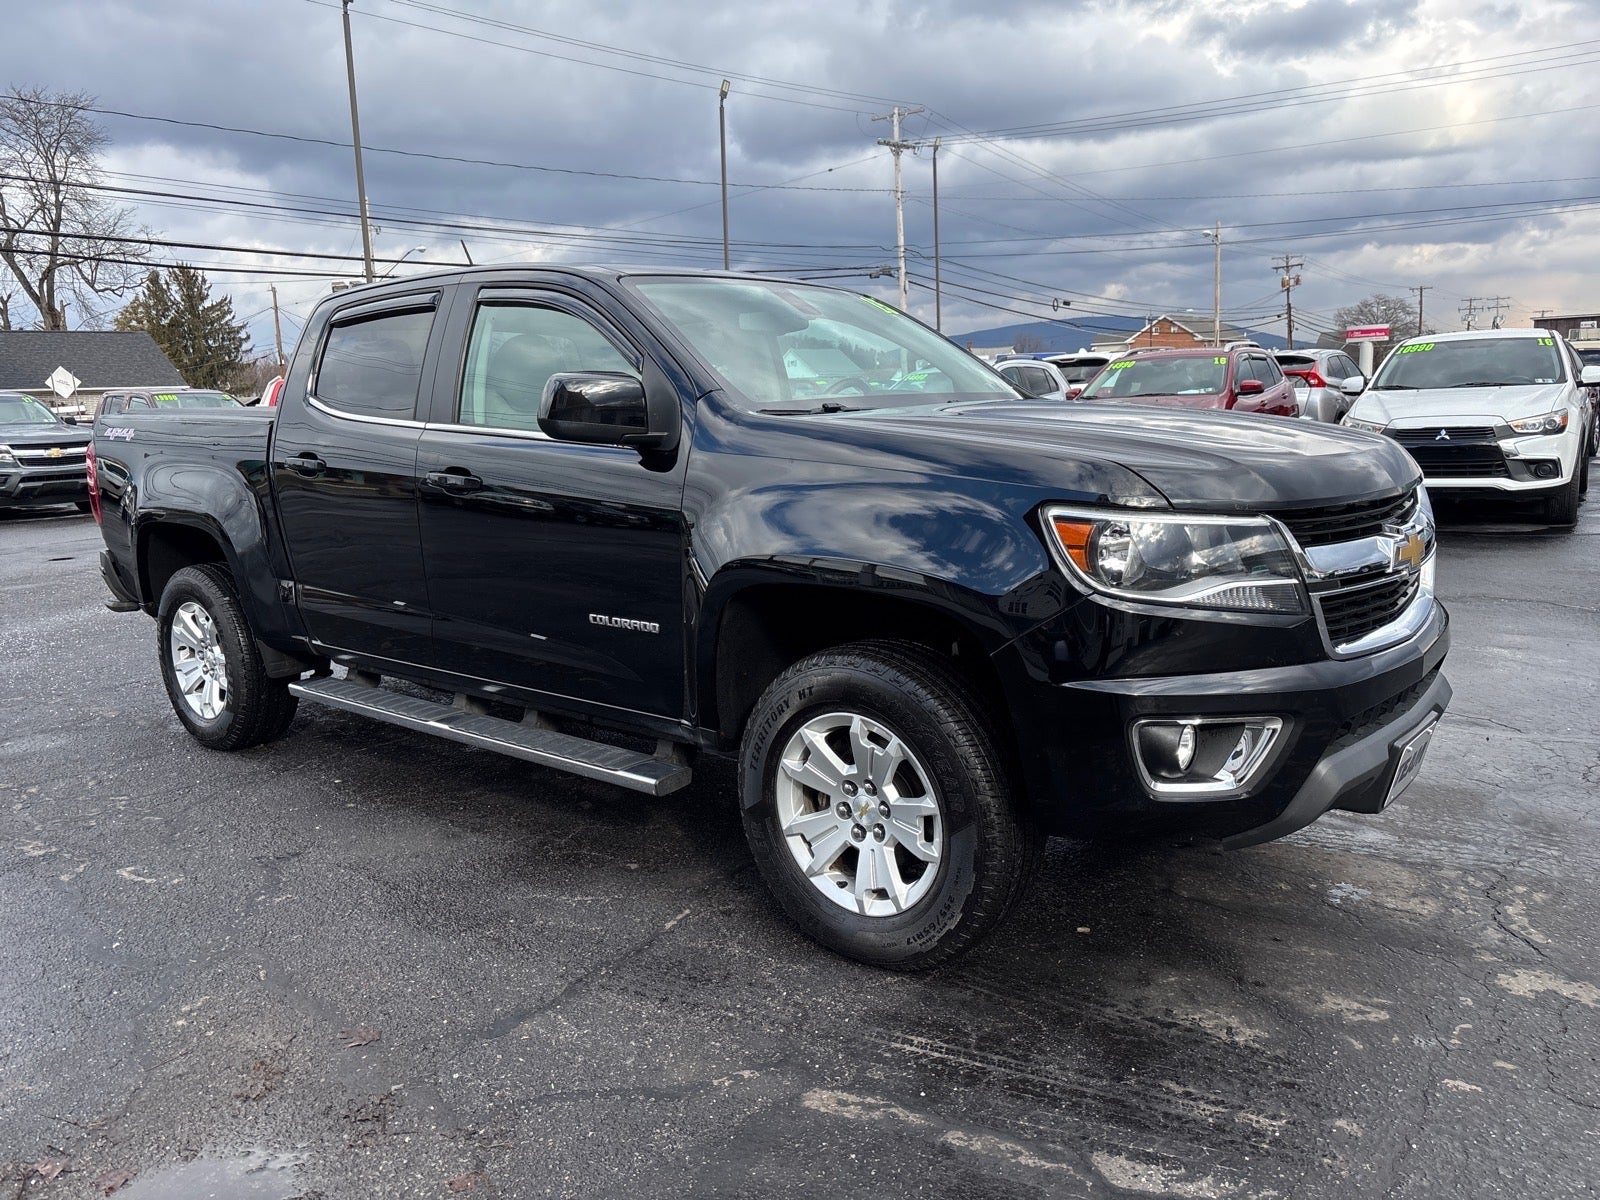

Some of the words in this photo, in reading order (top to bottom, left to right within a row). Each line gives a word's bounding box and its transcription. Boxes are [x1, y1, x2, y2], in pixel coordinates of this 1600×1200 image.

[1395, 343, 1435, 355] 10990
[588, 613, 660, 634] COLORADO
[750, 698, 790, 771] TERRITORY
[797, 686, 815, 701] HT
